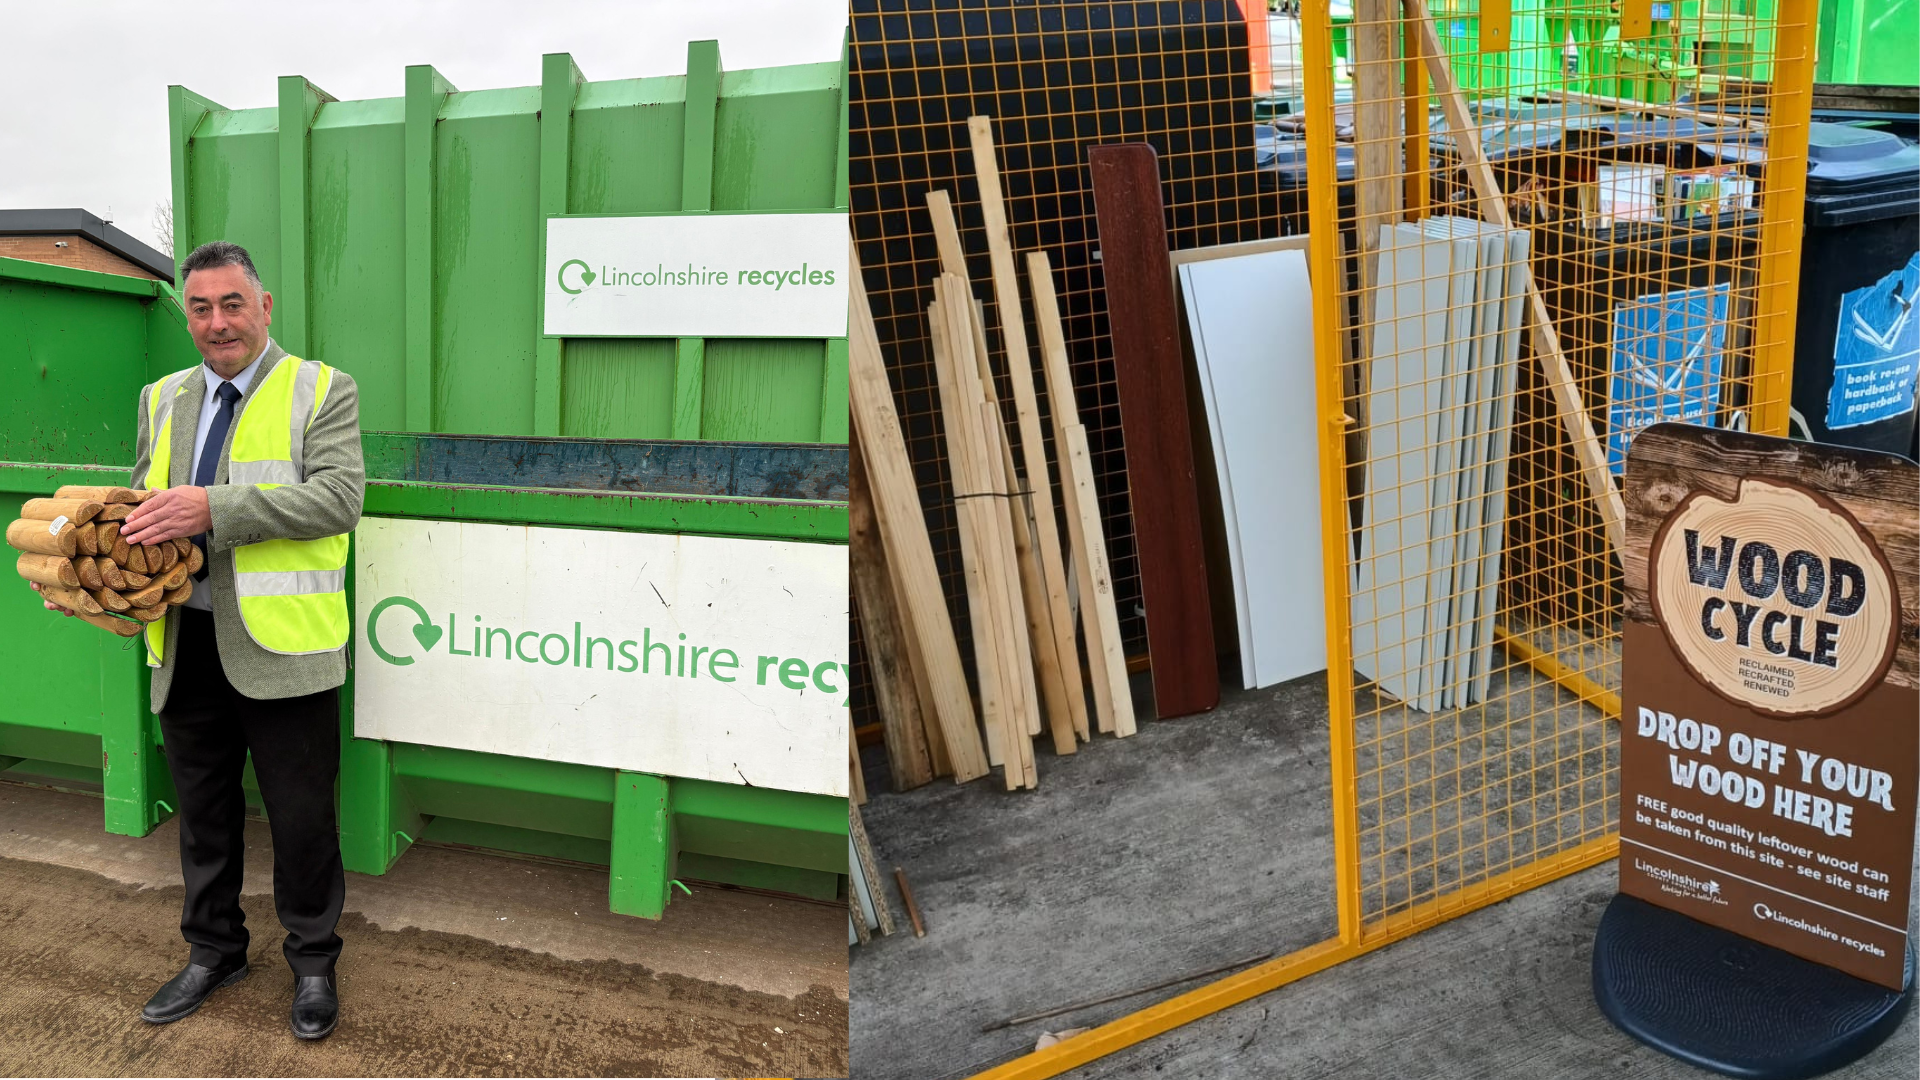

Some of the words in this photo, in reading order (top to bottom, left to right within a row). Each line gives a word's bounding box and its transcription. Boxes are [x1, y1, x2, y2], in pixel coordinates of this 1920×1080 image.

[601, 263, 729, 286] Lincolnshire
[737, 262, 836, 291] recycles
[1844, 380, 1896, 400] hardback
[1898, 378, 1909, 388] or
[1847, 370, 1877, 385] book
[1847, 391, 1903, 416] paperback
[1683, 528, 1867, 618] WOOD
[448, 613, 740, 683] Lincolnshire
[1701, 596, 1840, 669] CYCLE
[1738, 667, 1796, 690] RECRAFTED,
[1739, 657, 1796, 680] RECLAIMED,
[1743, 679, 1790, 697] RENEWED
[1637, 705, 1722, 755] DROP
[1728, 732, 1787, 775] OFF
[1795, 748, 1896, 812] YOUR
[1669, 754, 1766, 809] WOOD
[1772, 785, 1854, 838] HERE
[1636, 809, 1652, 825] be
[1655, 818, 1691, 838] taken
[1695, 829, 1727, 850] from
[1730, 842, 1756, 859] this
[1759, 852, 1785, 868] site
[1797, 864, 1822, 880] see
[1825, 873, 1852, 890] site
[1856, 882, 1891, 902] staff
[1637, 794, 1668, 813] FREE
[1670, 807, 1704, 825] good
[1707, 818, 1754, 843] quality
[1758, 831, 1813, 859] leftover
[1817, 852, 1859, 874] wood
[1862, 867, 1889, 883] can
[1635, 857, 1710, 892] Lincolnshire
[1773, 910, 1838, 941] Lincolnshire
[1841, 935, 1886, 957] recycles
